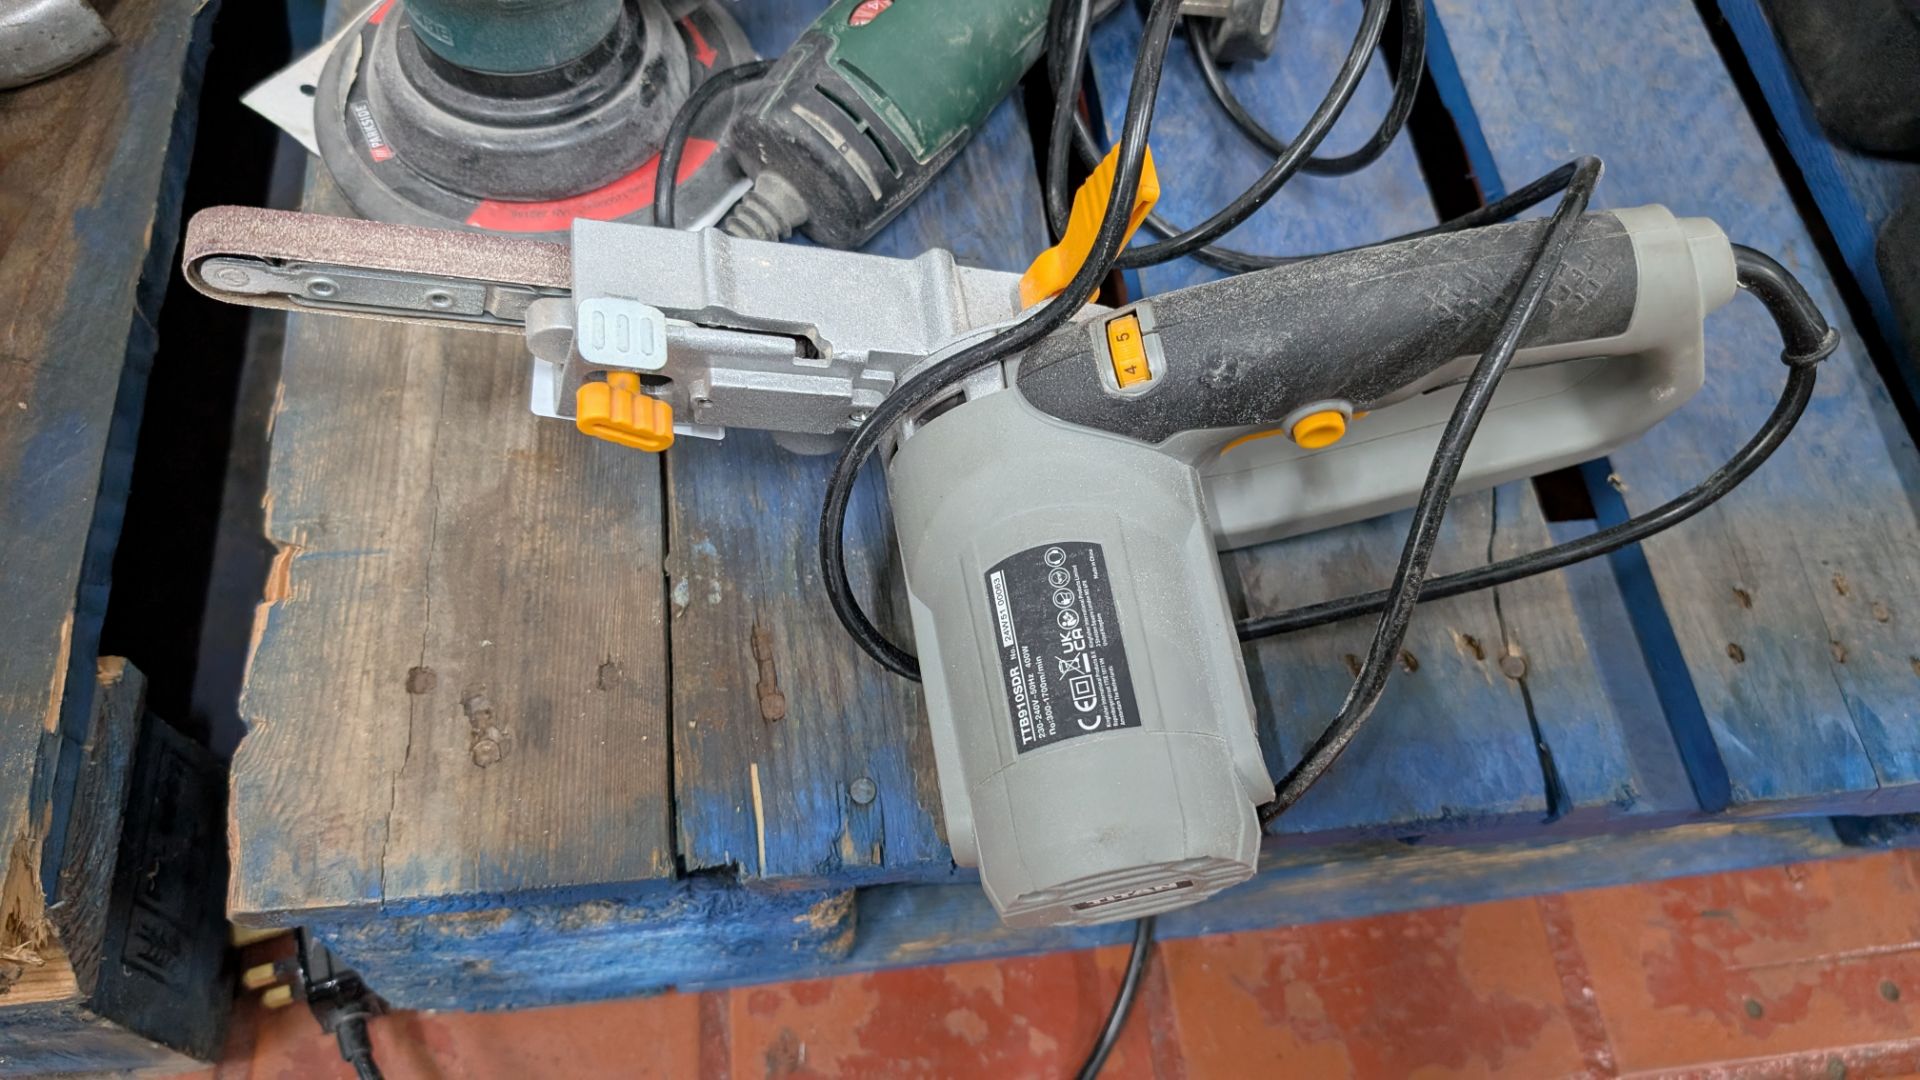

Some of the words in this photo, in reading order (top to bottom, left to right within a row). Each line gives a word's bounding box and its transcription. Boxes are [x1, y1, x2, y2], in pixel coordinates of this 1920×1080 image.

[355, 104, 384, 148] PARKSIDE
[1116, 332, 1130, 342] 5
[1124, 365, 1137, 375] 4
[1060, 631, 1074, 654] UK
[1072, 628, 1086, 651] CA
[1009, 646, 1018, 661] No.
[1022, 646, 1032, 668] 400W
[1010, 666, 1033, 745] TTB910SDR
[1086, 881, 1178, 905] TITAN
